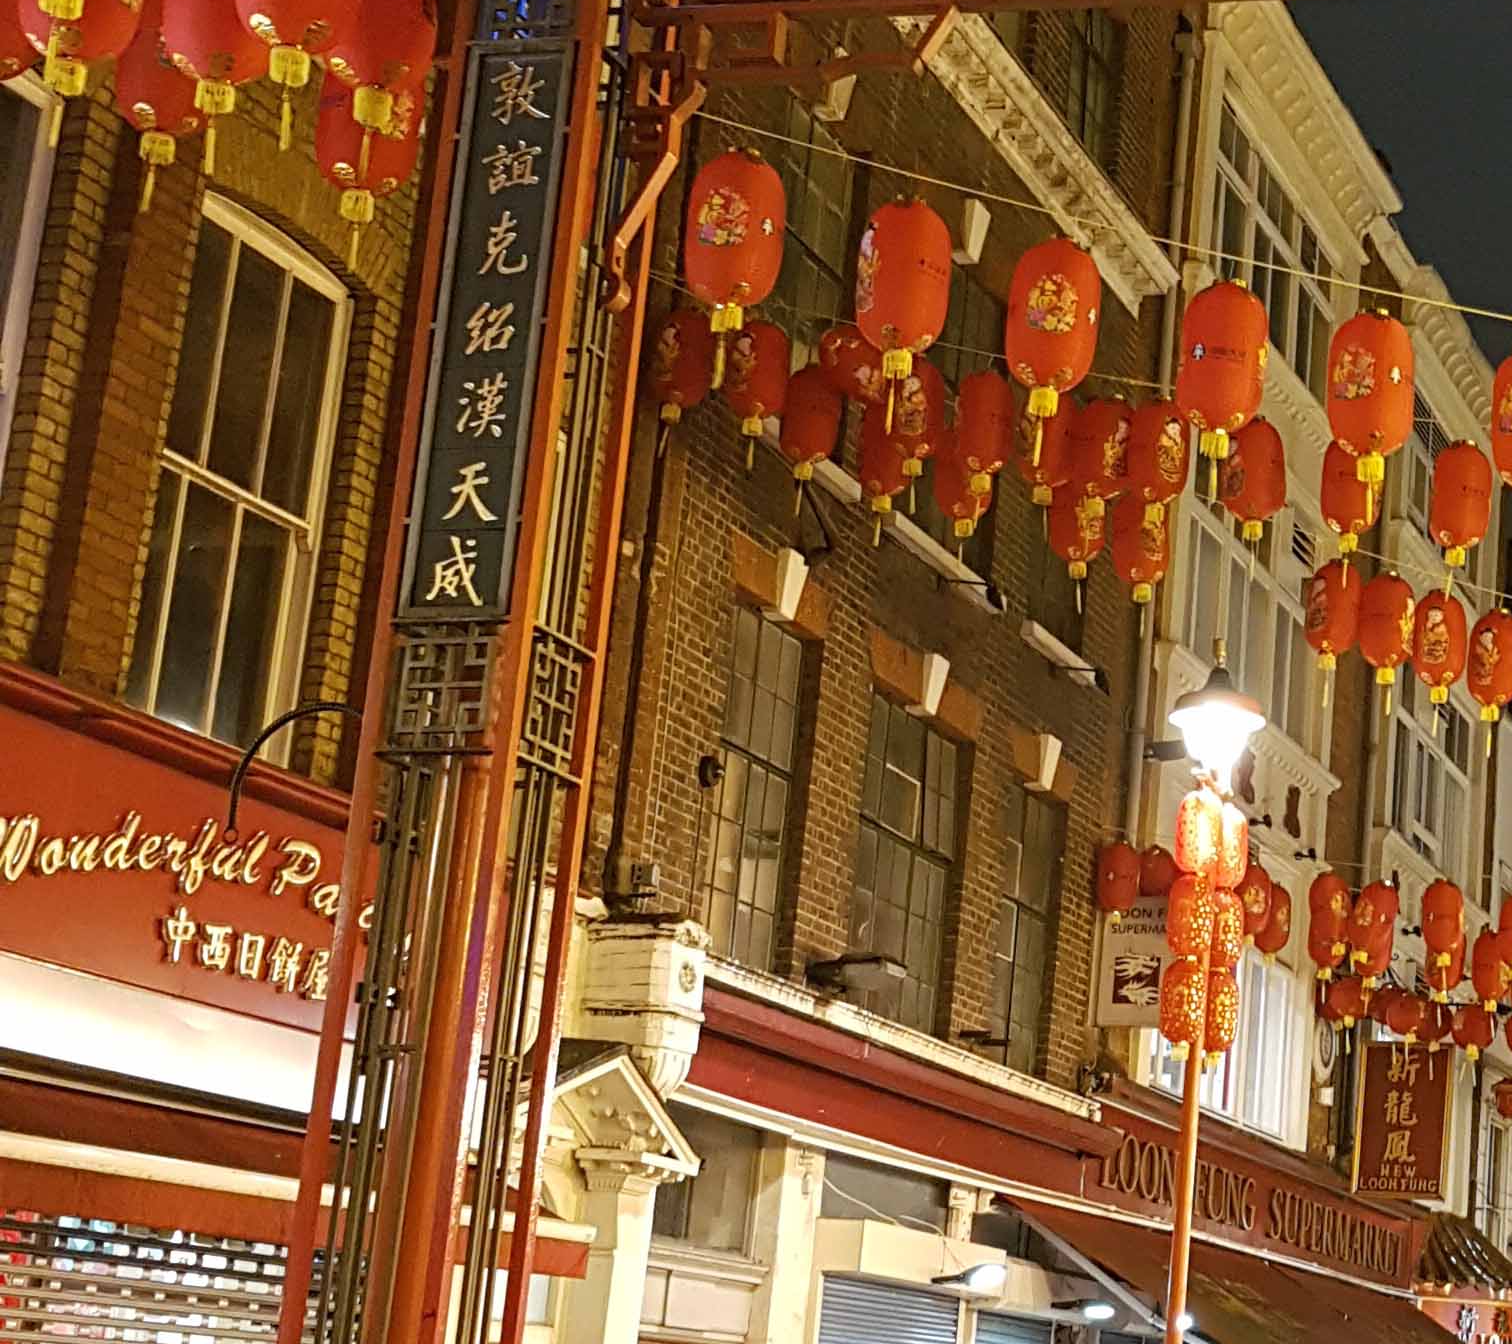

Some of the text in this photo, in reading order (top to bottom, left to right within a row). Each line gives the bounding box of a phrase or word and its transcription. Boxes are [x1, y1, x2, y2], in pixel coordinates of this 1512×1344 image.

[1101, 1134, 1406, 1277] LOON FUNG SUPERMARKET
